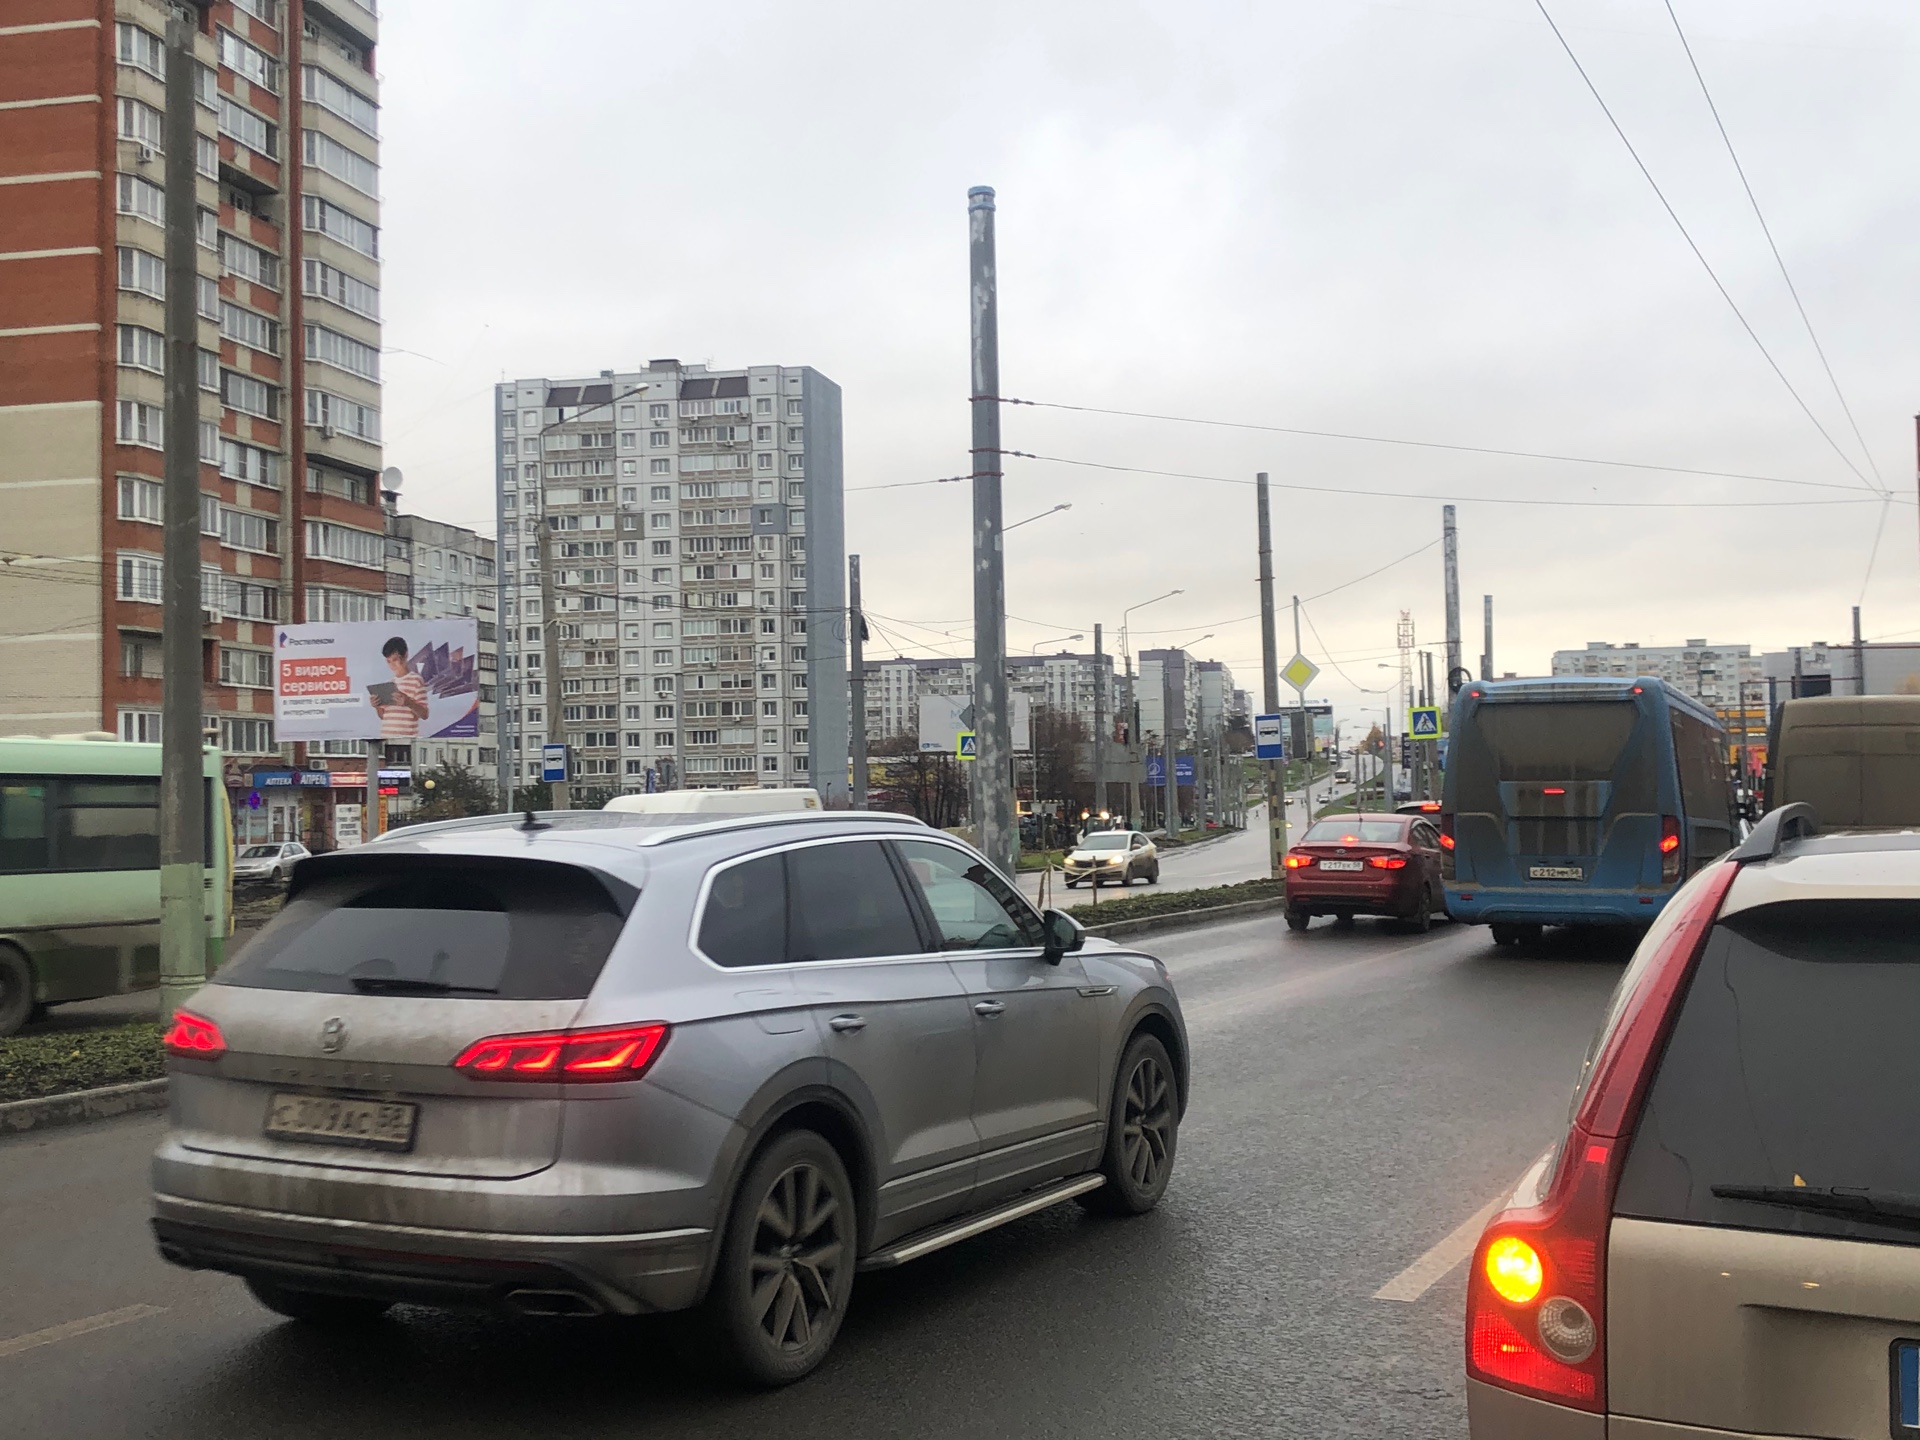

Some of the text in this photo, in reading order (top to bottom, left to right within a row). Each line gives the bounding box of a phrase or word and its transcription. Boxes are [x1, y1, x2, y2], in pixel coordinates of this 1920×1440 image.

[282, 664, 344, 678] 5 видео-
[282, 680, 347, 695] сервисов
